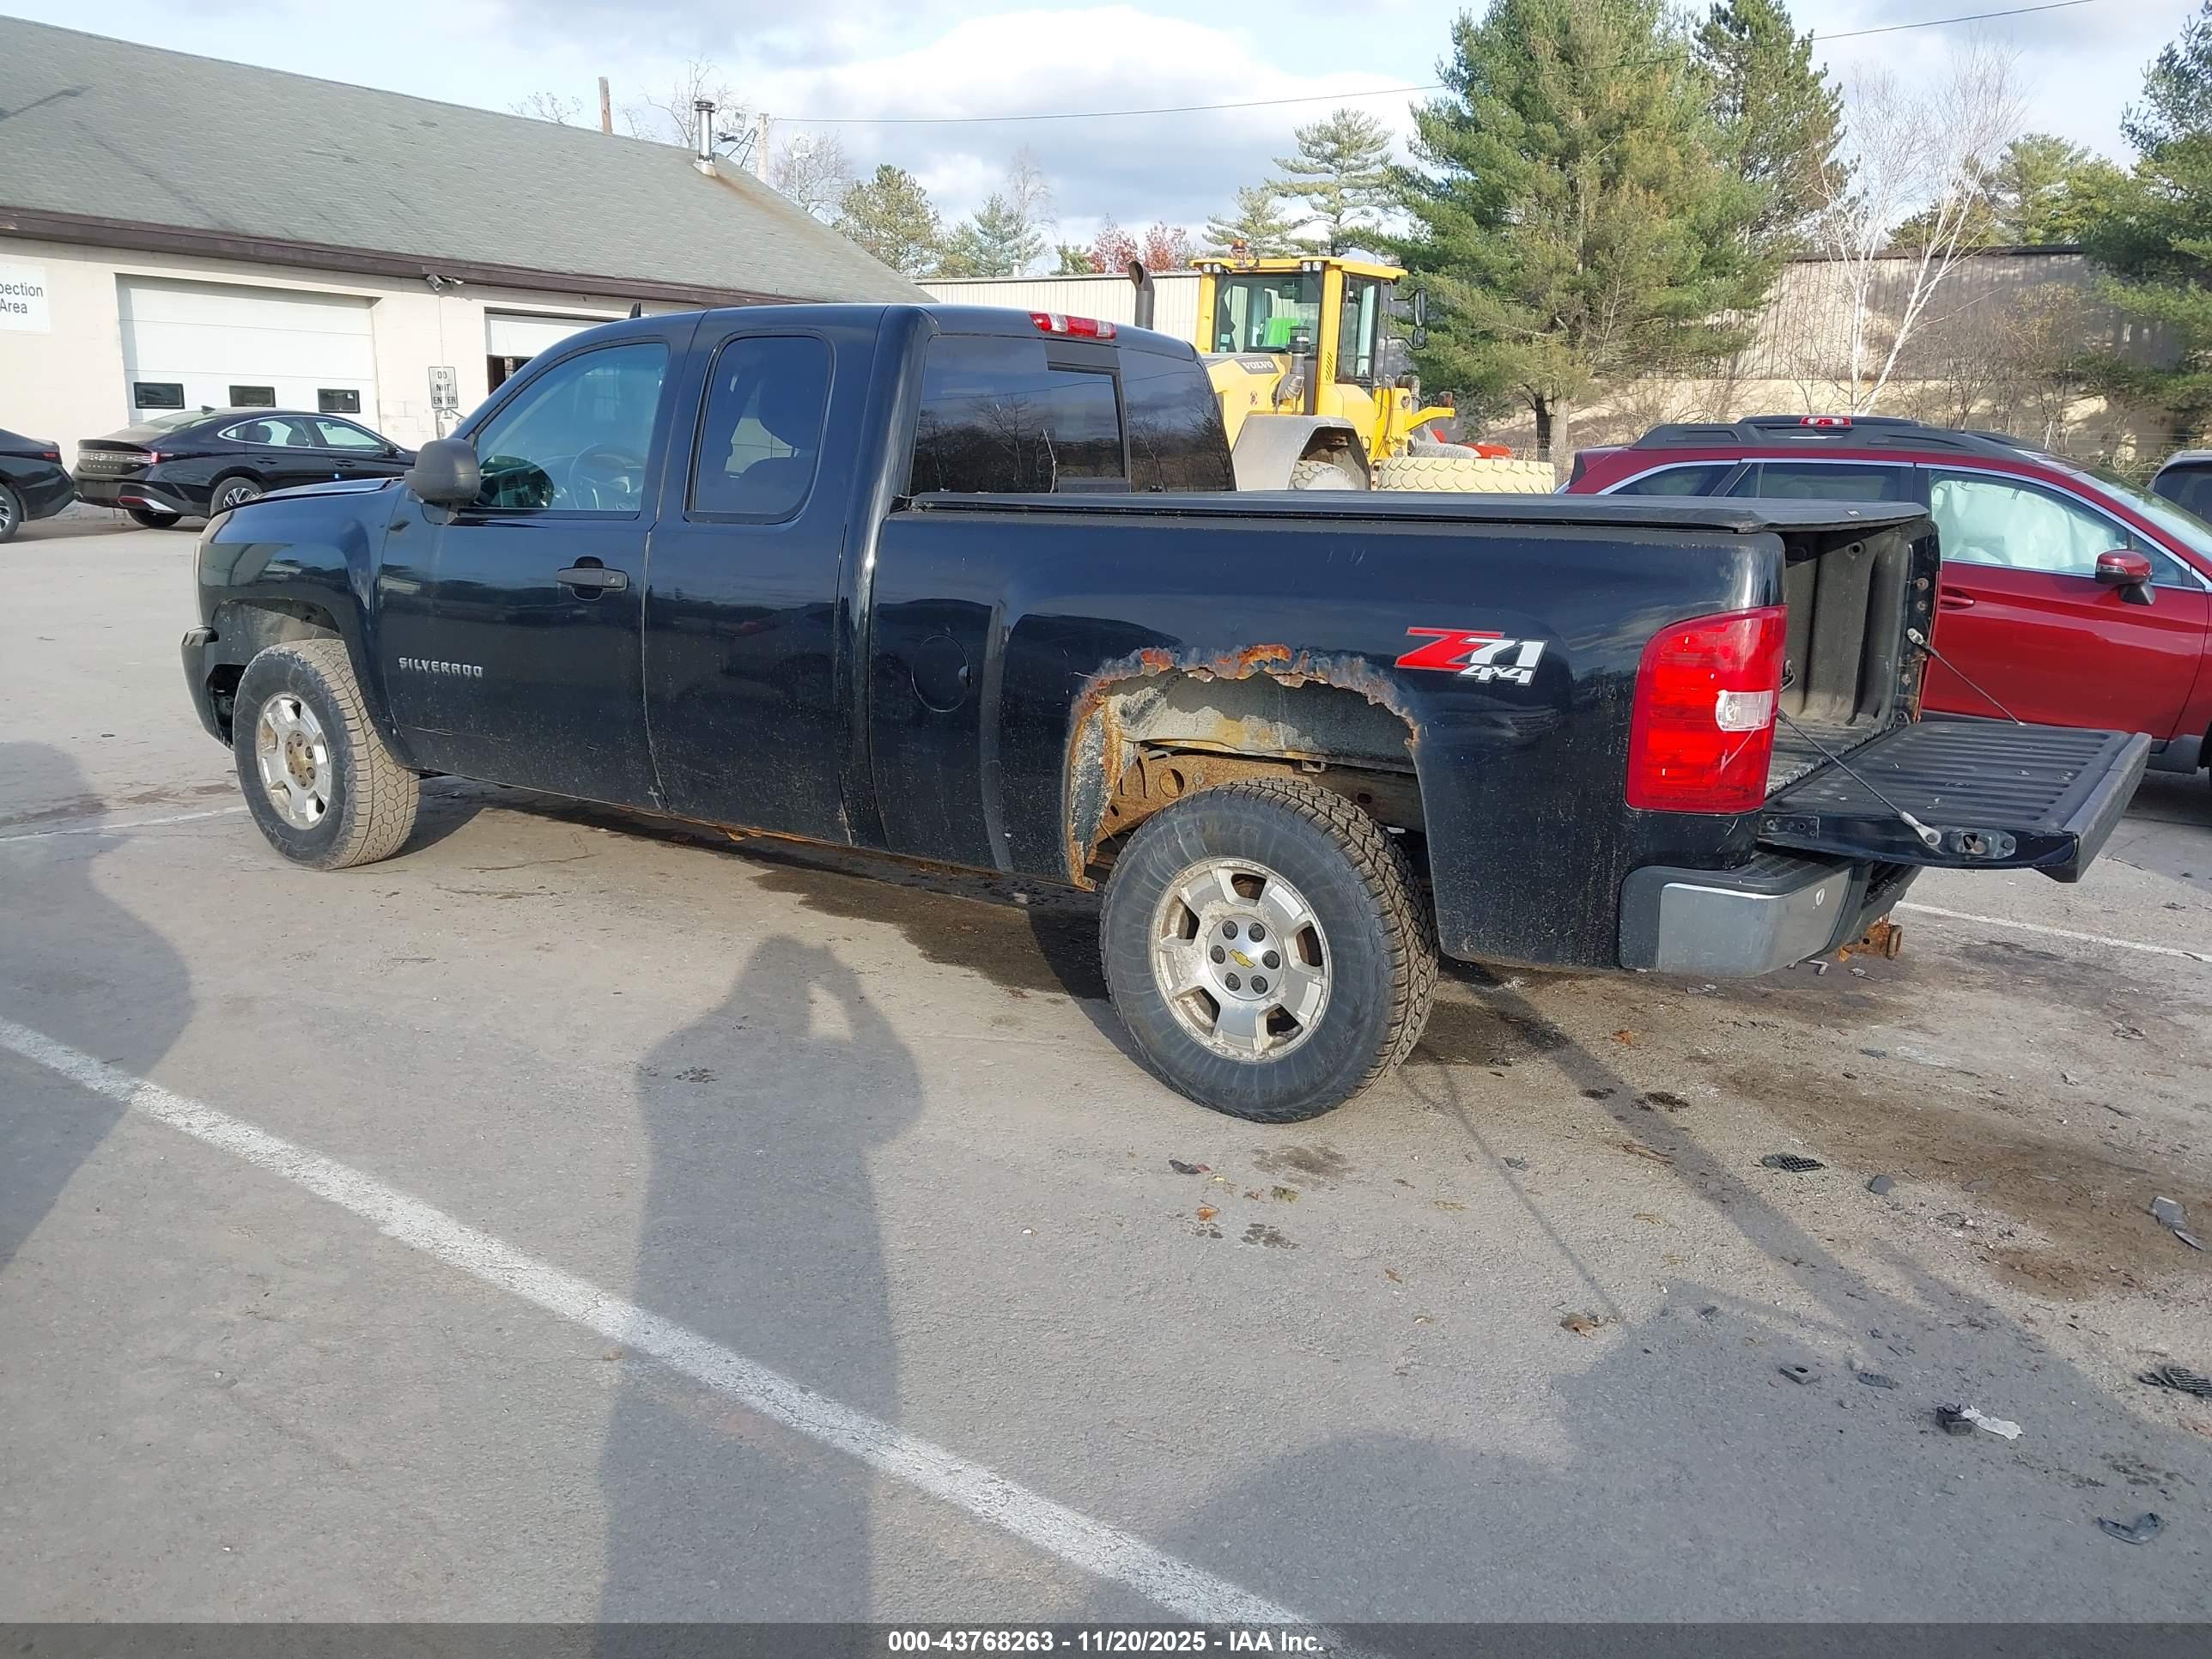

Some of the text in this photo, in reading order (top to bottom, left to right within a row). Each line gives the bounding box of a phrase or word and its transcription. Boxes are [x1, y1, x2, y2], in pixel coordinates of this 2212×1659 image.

[0, 298, 27, 314] Area
[1242, 361, 1274, 370] VOLVO
[437, 370, 447, 379] DO
[433, 396, 456, 404] ENER
[1395, 627, 1548, 672] Z71
[398, 657, 483, 678] SILVERADO
